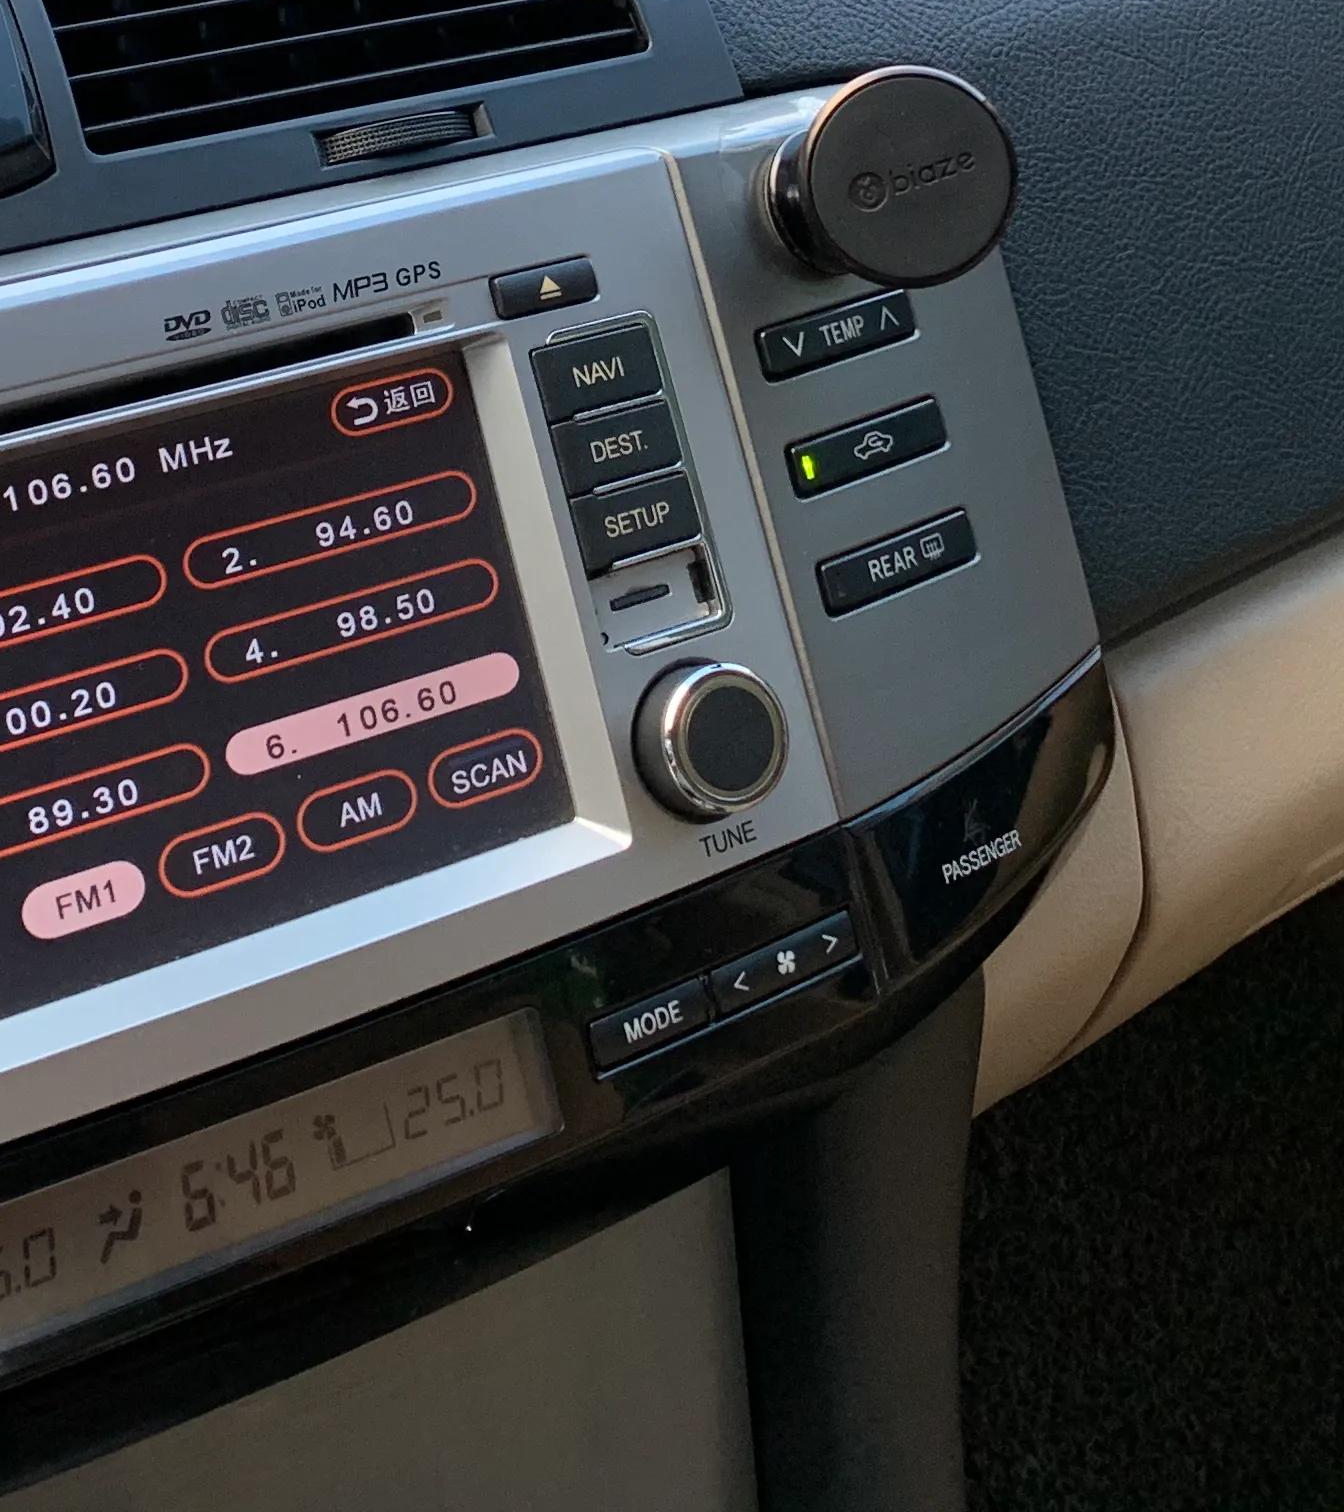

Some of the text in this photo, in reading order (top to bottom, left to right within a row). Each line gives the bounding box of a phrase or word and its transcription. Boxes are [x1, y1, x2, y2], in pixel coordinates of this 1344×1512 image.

[888, 150, 976, 196] biaze
[290, 288, 310, 298] Made
[332, 272, 389, 303] MP3
[395, 261, 442, 288] GPS
[163, 310, 211, 333] DVD
[293, 294, 327, 313] iPod
[818, 315, 865, 347] TEMP
[572, 356, 626, 388] NAVI
[383, 381, 436, 415] 返回
[590, 430, 649, 464] DEST.
[2, 435, 233, 513] 106.60 MHz
[221, 499, 415, 575] 2. 94.60
[604, 502, 672, 539] SETUP
[867, 546, 918, 583] REAR
[245, 588, 436, 665] 4. 98.50
[266, 681, 457, 759] 6. 106.60
[451, 750, 529, 794] SCAN
[27, 778, 139, 835] 89.30
[339, 791, 383, 828] AM
[192, 834, 256, 875] FM2
[698, 820, 758, 859] TUNE
[941, 829, 1023, 885] PASSENGER
[55, 878, 118, 920] FM1
[623, 999, 684, 1044] MODE
[404, 1058, 506, 1141] 25.0
[179, 1128, 297, 1233] 6:46
